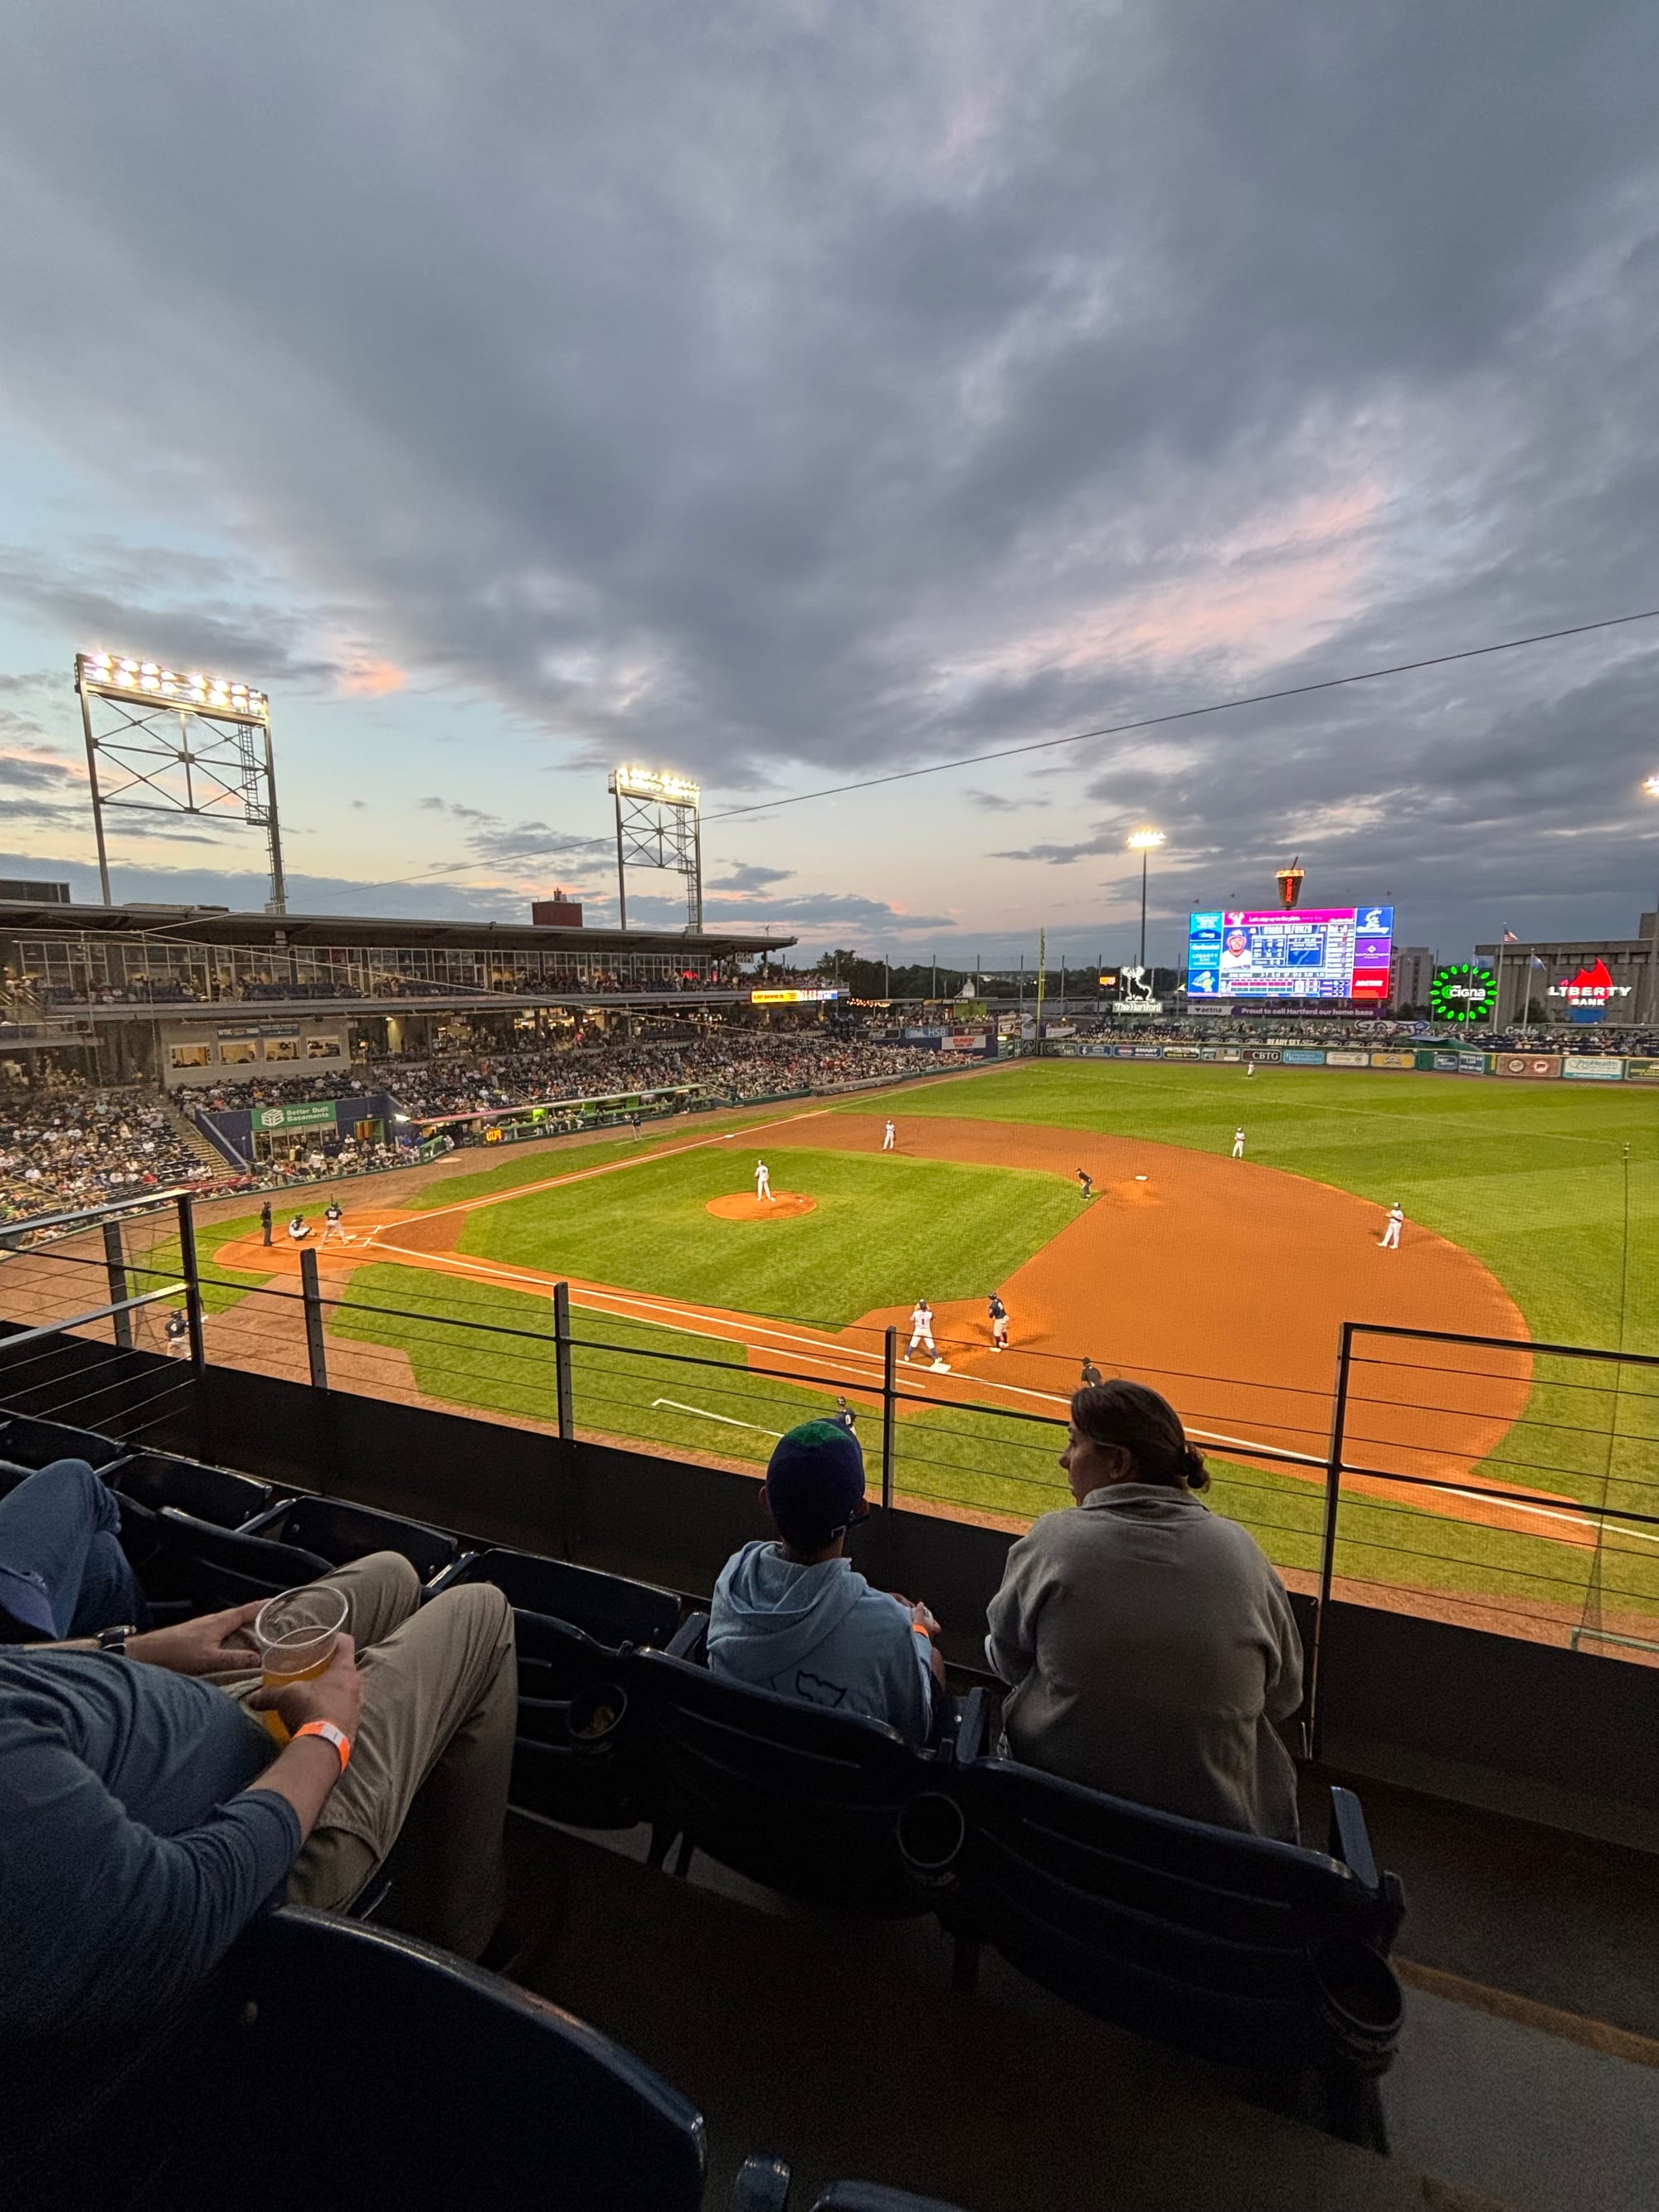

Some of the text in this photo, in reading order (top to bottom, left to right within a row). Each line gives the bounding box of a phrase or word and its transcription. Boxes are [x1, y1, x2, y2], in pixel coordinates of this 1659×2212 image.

[1549, 986, 1632, 997] LIBERTY
[1571, 998, 1605, 1006] BANK
[927, 1028, 946, 1037] HSB
[1252, 1051, 1279, 1060] CBTG
[287, 1112, 329, 1122] Basements
